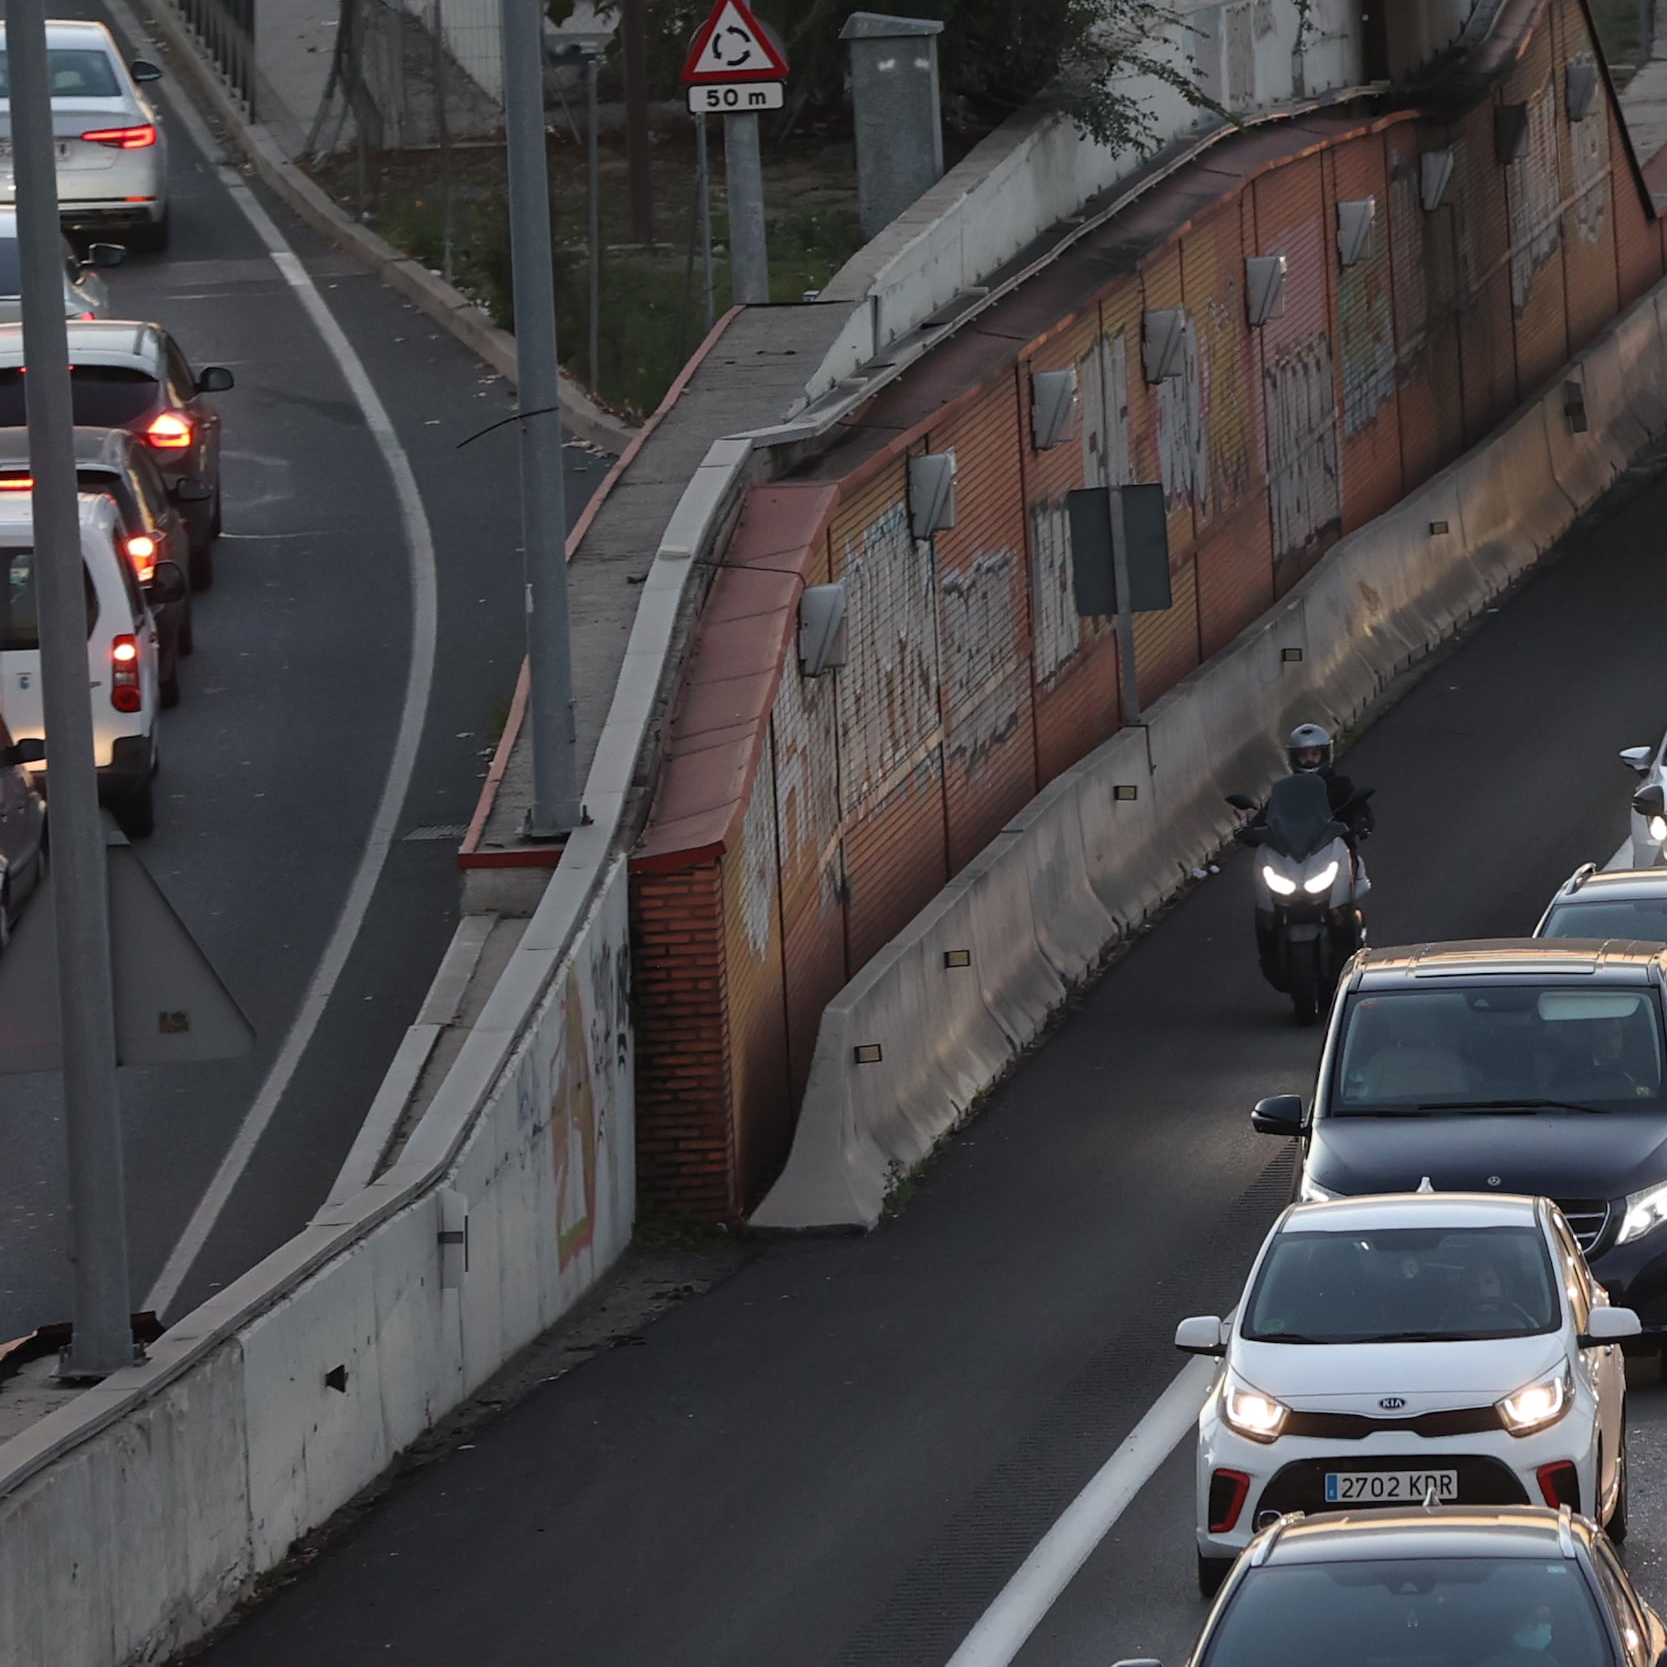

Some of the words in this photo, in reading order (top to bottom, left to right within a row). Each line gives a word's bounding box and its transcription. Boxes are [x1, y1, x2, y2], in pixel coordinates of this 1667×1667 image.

[706, 88, 739, 108] 50
[748, 91, 767, 105] m
[1383, 1399, 1404, 1407] KIA
[1341, 1476, 1400, 1499] 2702
[1409, 1474, 1453, 1497] KDR
